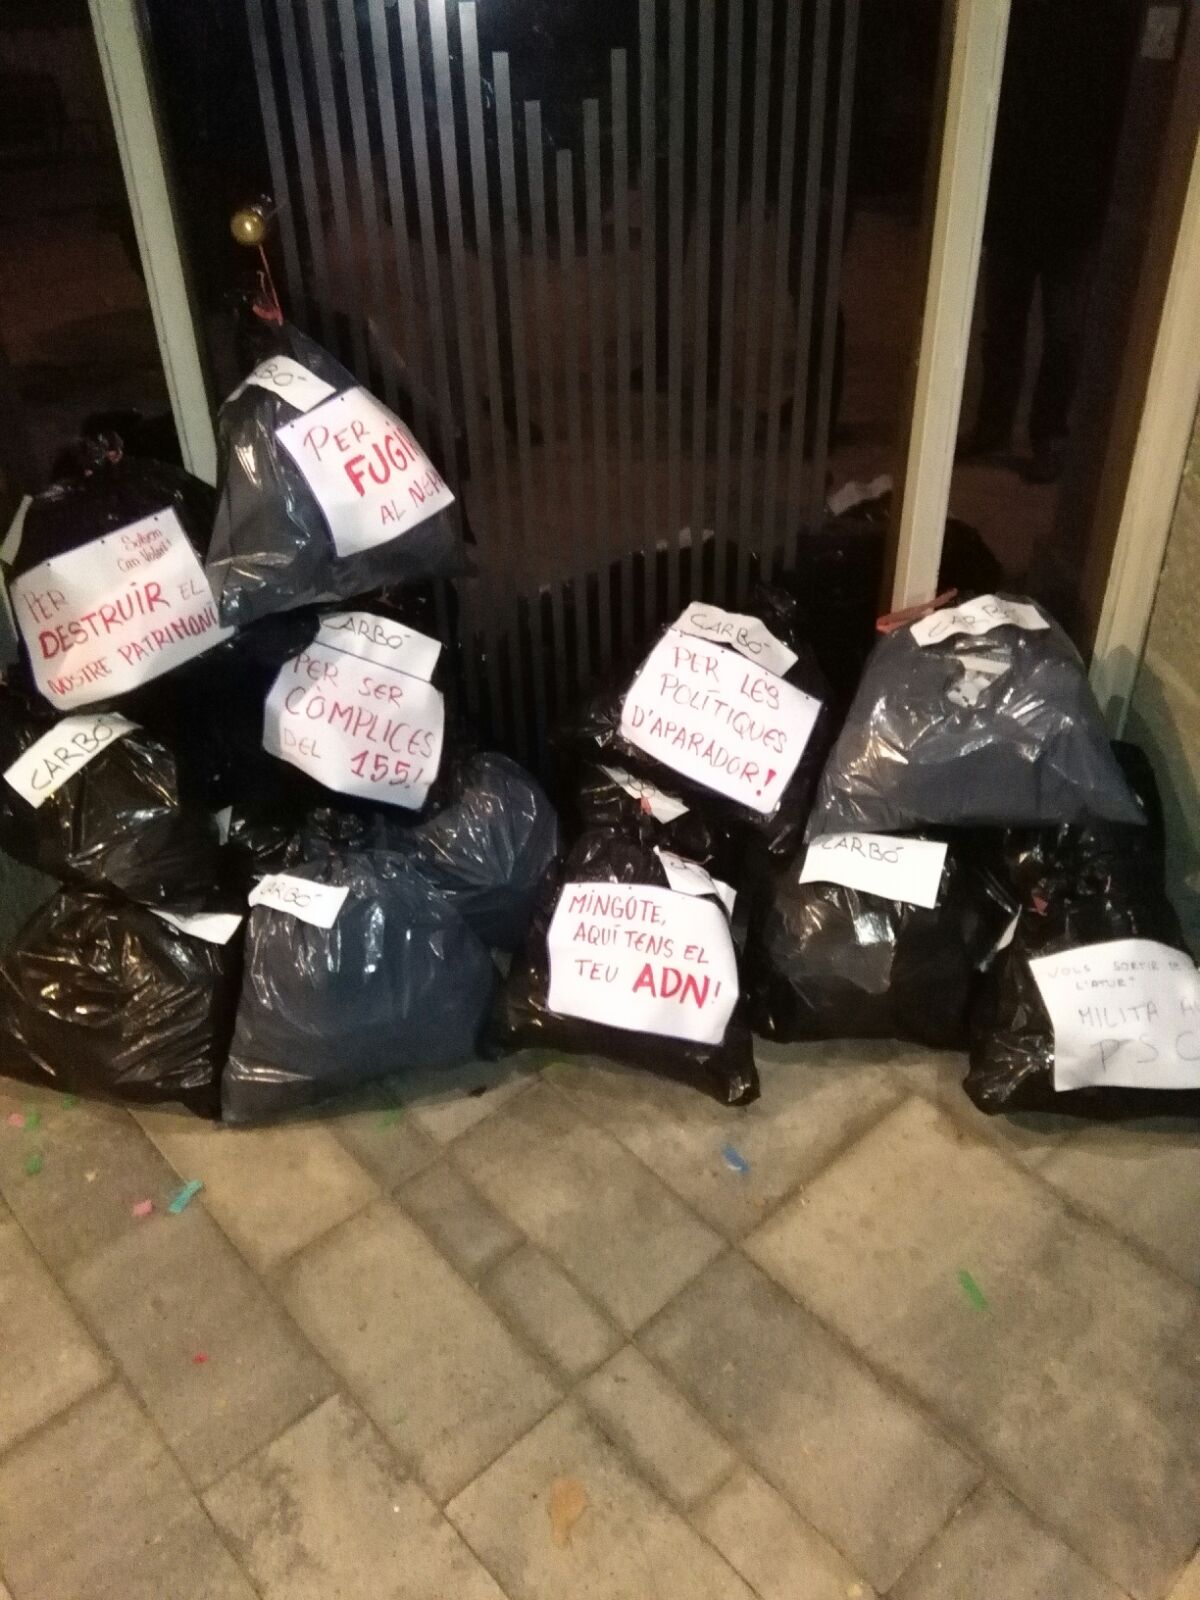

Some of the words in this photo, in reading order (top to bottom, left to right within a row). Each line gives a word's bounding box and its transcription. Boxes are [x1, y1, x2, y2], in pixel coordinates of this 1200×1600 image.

[303, 420, 370, 461] PER
[380, 500, 406, 525] AL
[38, 581, 172, 659] DESTRUIR
[179, 579, 204, 600] EL
[117, 606, 218, 667] PATRIMONI
[294, 653, 339, 687] PER
[359, 676, 403, 708] SER
[674, 646, 720, 682] PER
[740, 674, 780, 711] LES
[660, 672, 788, 754] POLÍTIQUES
[284, 727, 321, 759] DEL
[351, 750, 424, 788] 155!
[575, 959, 619, 983] TEU
[625, 930, 675, 958] TENS
[684, 944, 710, 964] EL
[1078, 1000, 1158, 1029] MILITA
